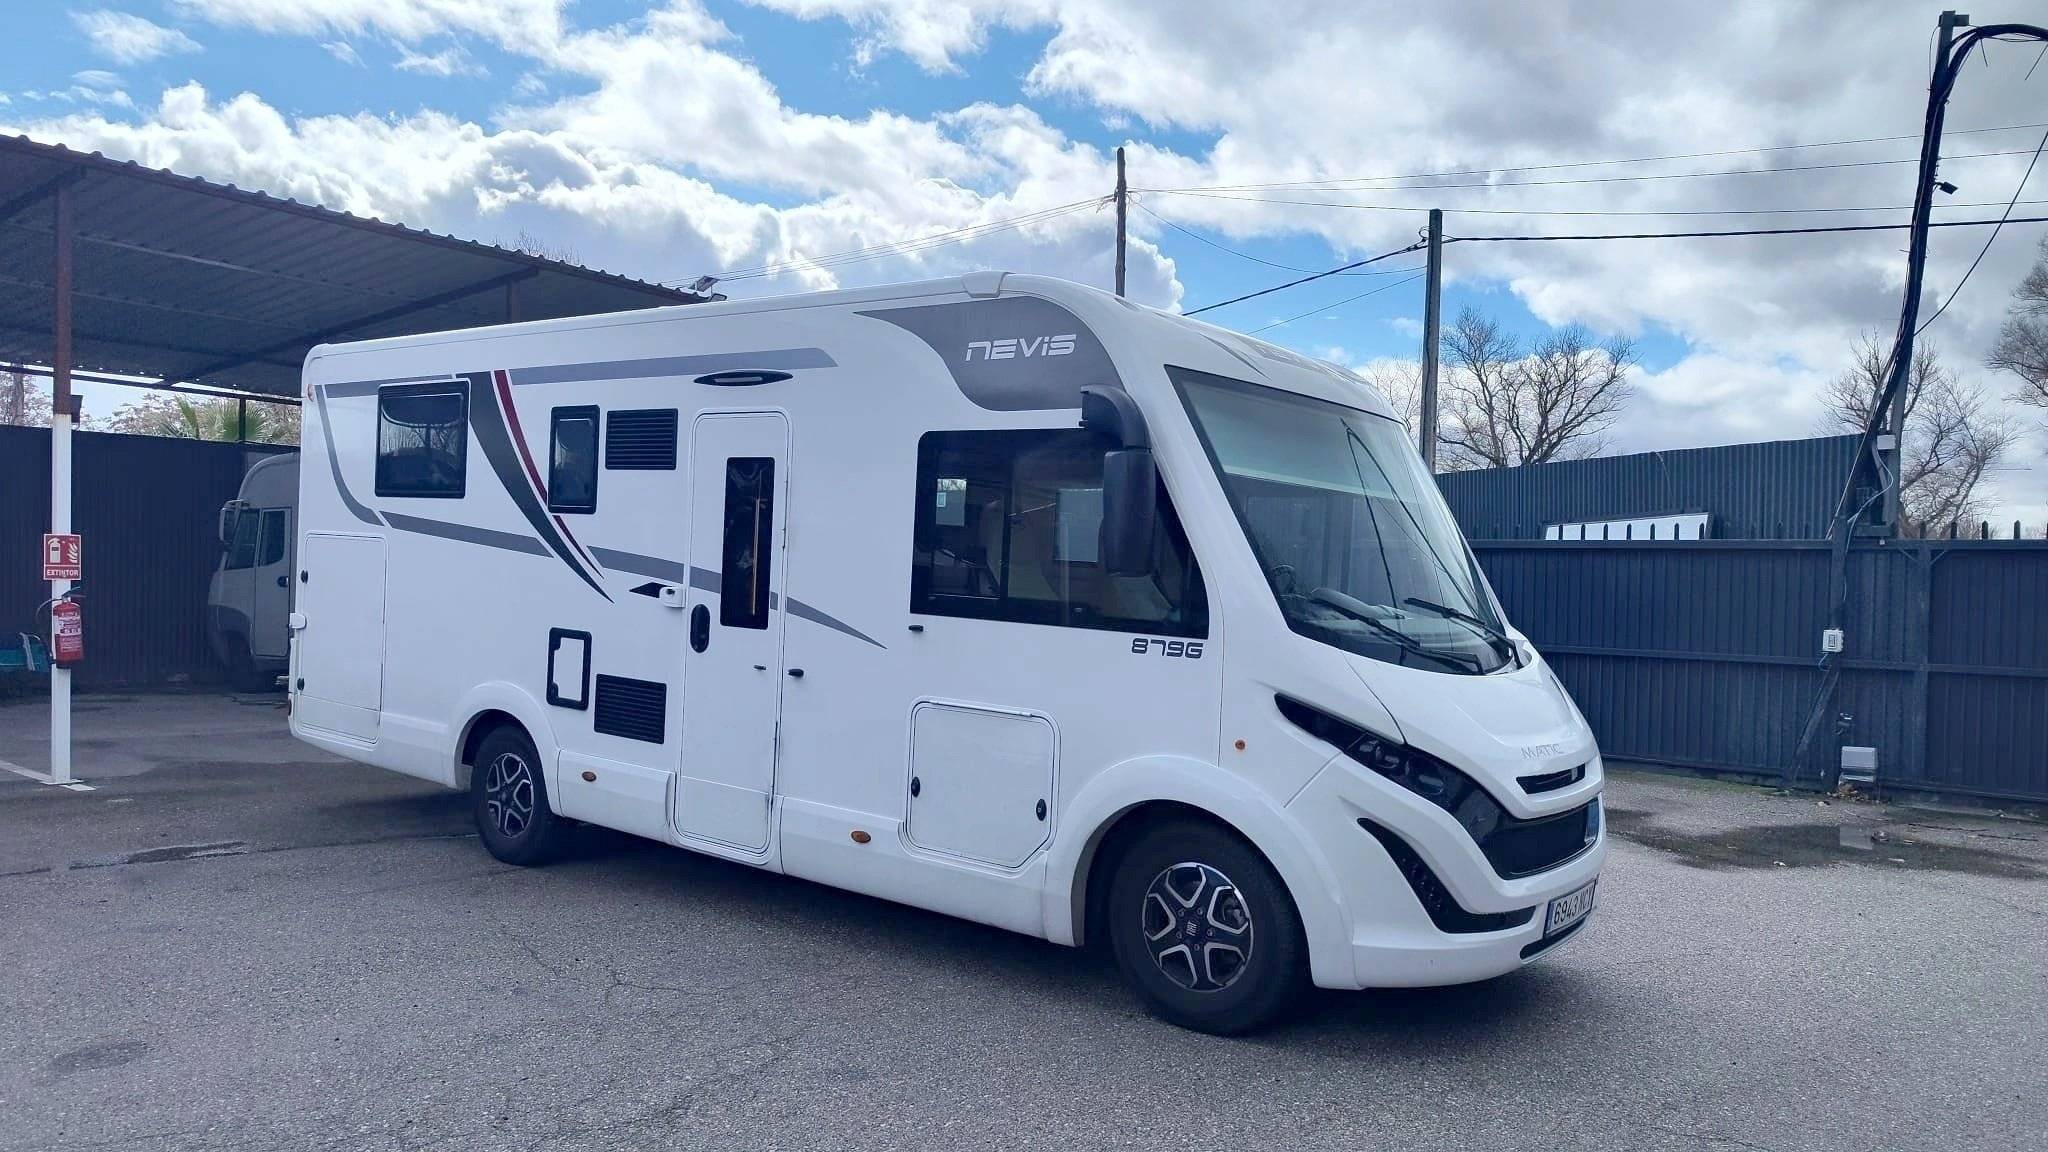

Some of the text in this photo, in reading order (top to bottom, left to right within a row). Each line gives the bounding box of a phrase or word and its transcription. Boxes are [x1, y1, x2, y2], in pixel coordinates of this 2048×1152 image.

[46, 569, 79, 577] EXTINTOR
[1132, 638, 1204, 659] 879G
[1554, 896, 1579, 924] 6943
